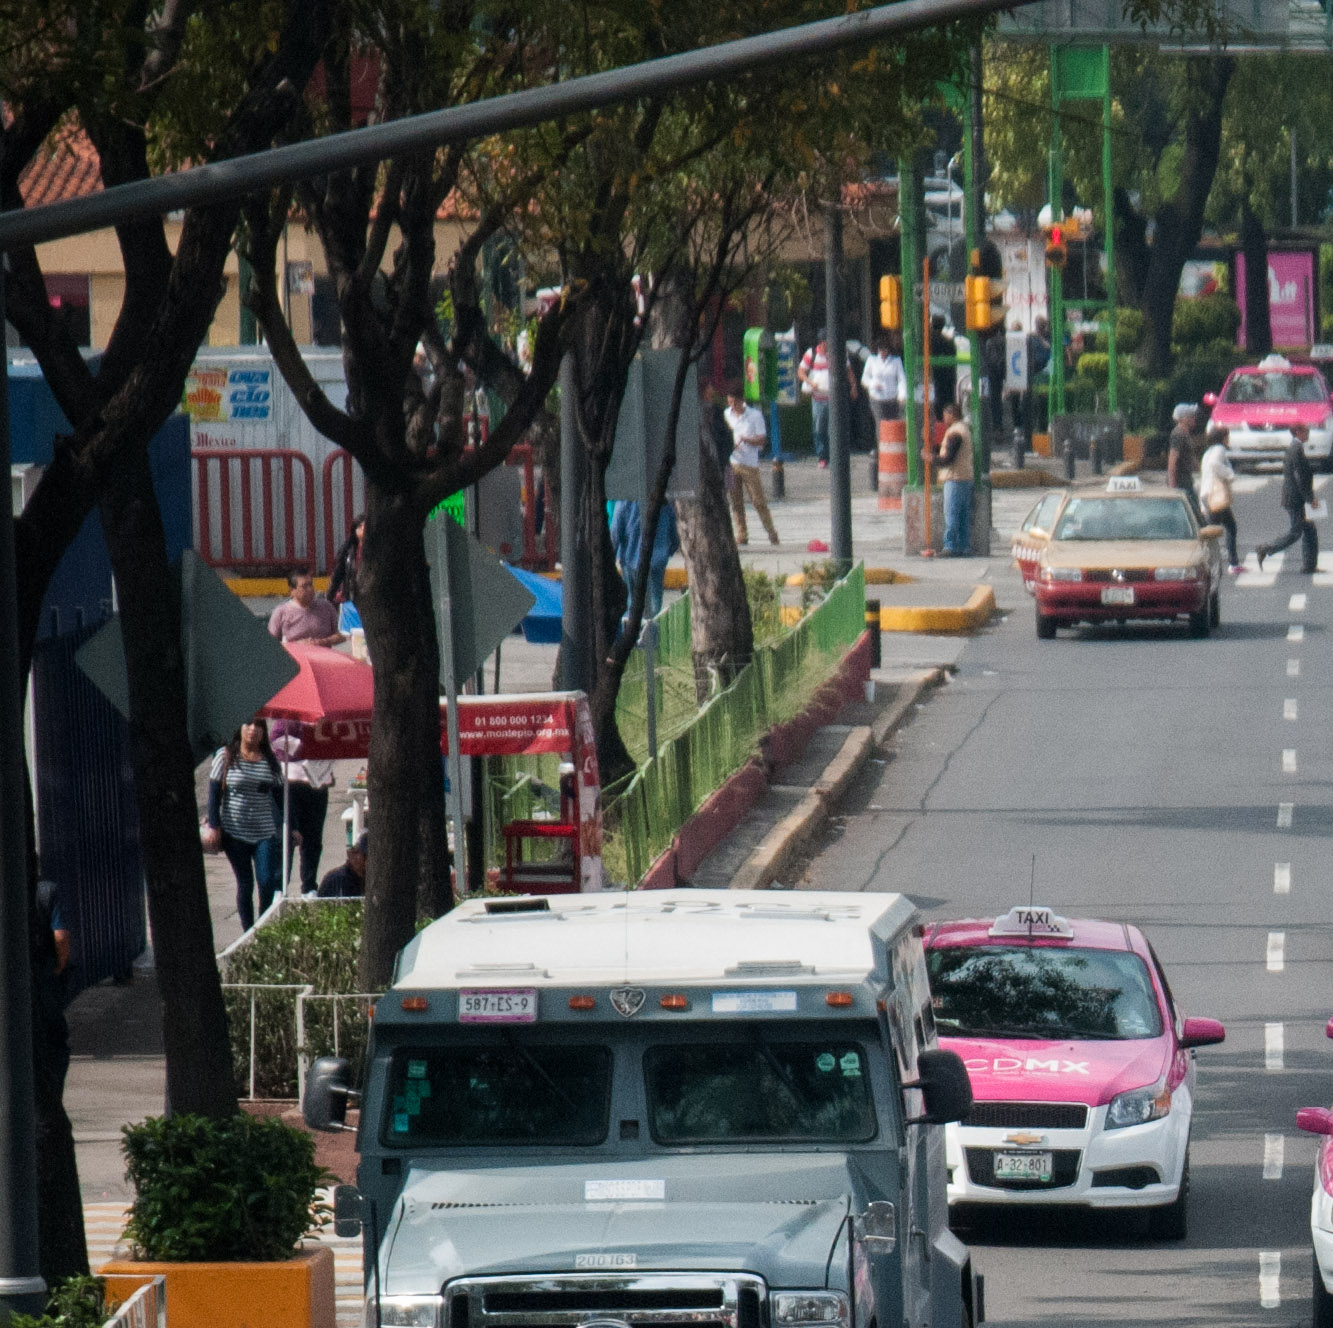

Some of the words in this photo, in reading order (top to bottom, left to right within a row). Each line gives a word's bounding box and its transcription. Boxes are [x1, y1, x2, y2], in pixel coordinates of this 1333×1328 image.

[475, 717, 486, 725] 01
[489, 716, 507, 725] 800
[509, 716, 527, 725] 000
[531, 714, 554, 724] 1234
[1016, 911, 1049, 924] TAXI
[964, 1058, 1090, 1075] CDMX
[997, 1158, 1047, 1172] A-32-801
